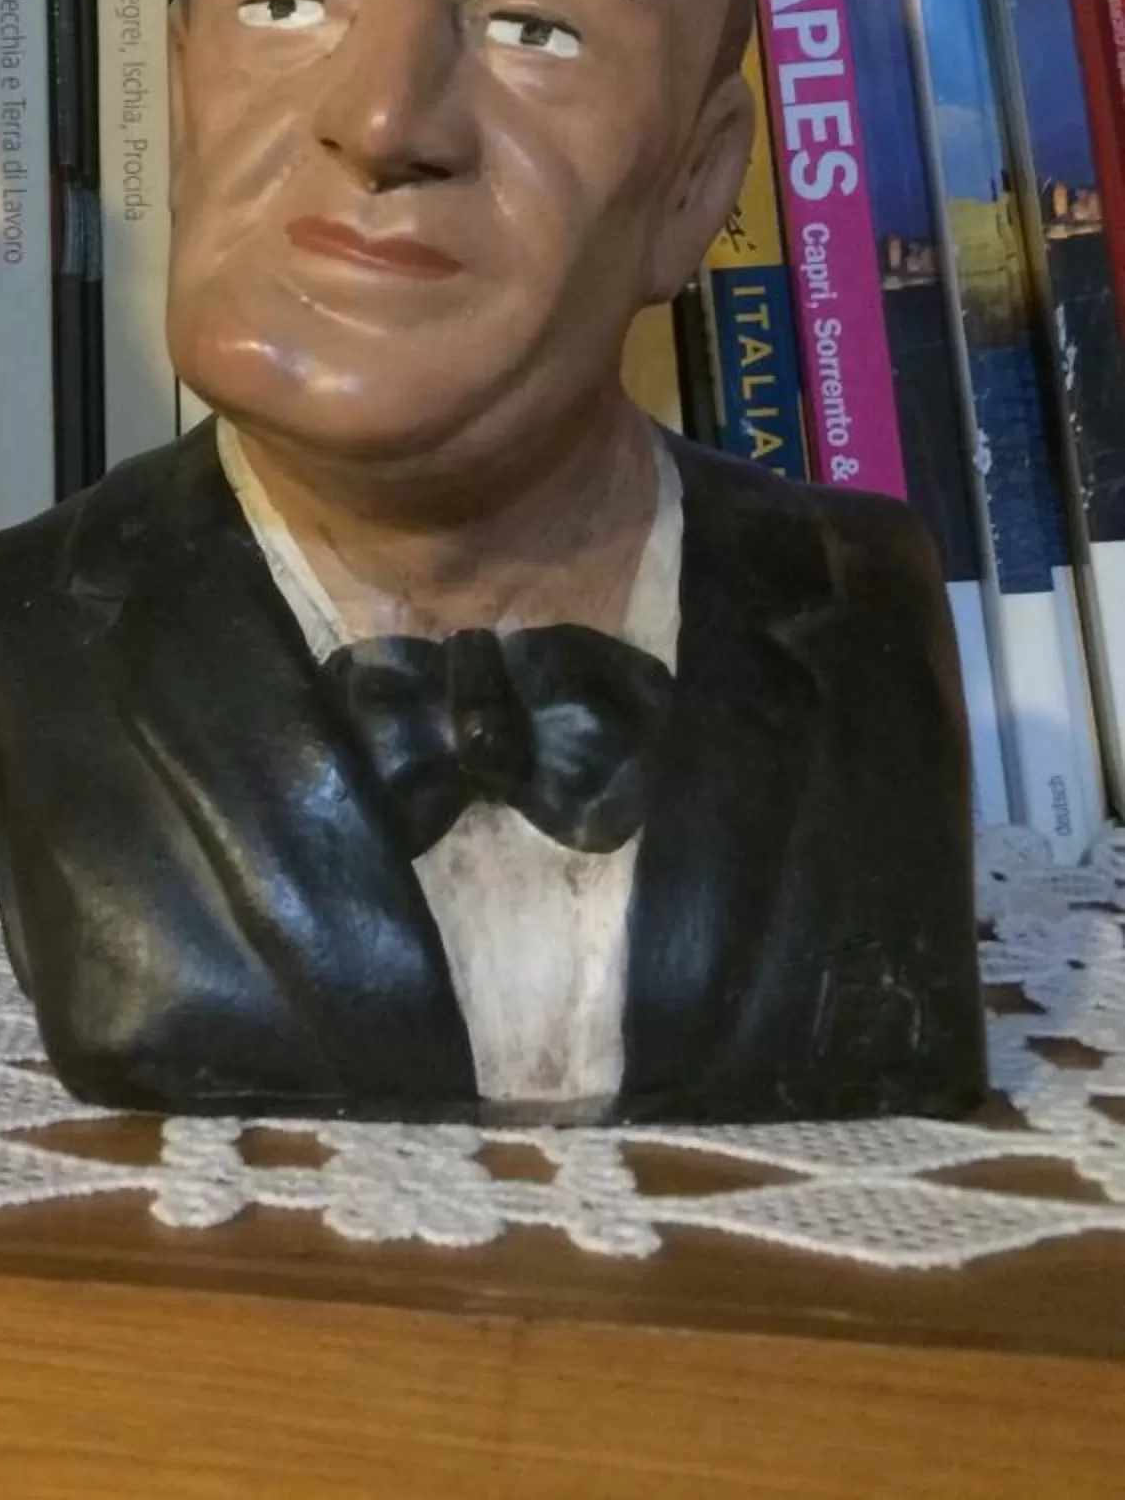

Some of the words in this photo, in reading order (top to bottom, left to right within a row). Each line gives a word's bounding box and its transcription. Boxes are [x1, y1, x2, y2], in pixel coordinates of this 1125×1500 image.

[0, 77, 19, 90] e
[119, 61, 149, 130] Ischia,
[0, 99, 26, 152] Terra
[2, 163, 28, 184] di
[123, 139, 151, 222] Procida
[2, 189, 26, 265] Lavoro
[800, 222, 839, 309] Capri,
[732, 285, 787, 477] ITALIA
[813, 318, 853, 447] Sorrento
[830, 455, 860, 482] &
